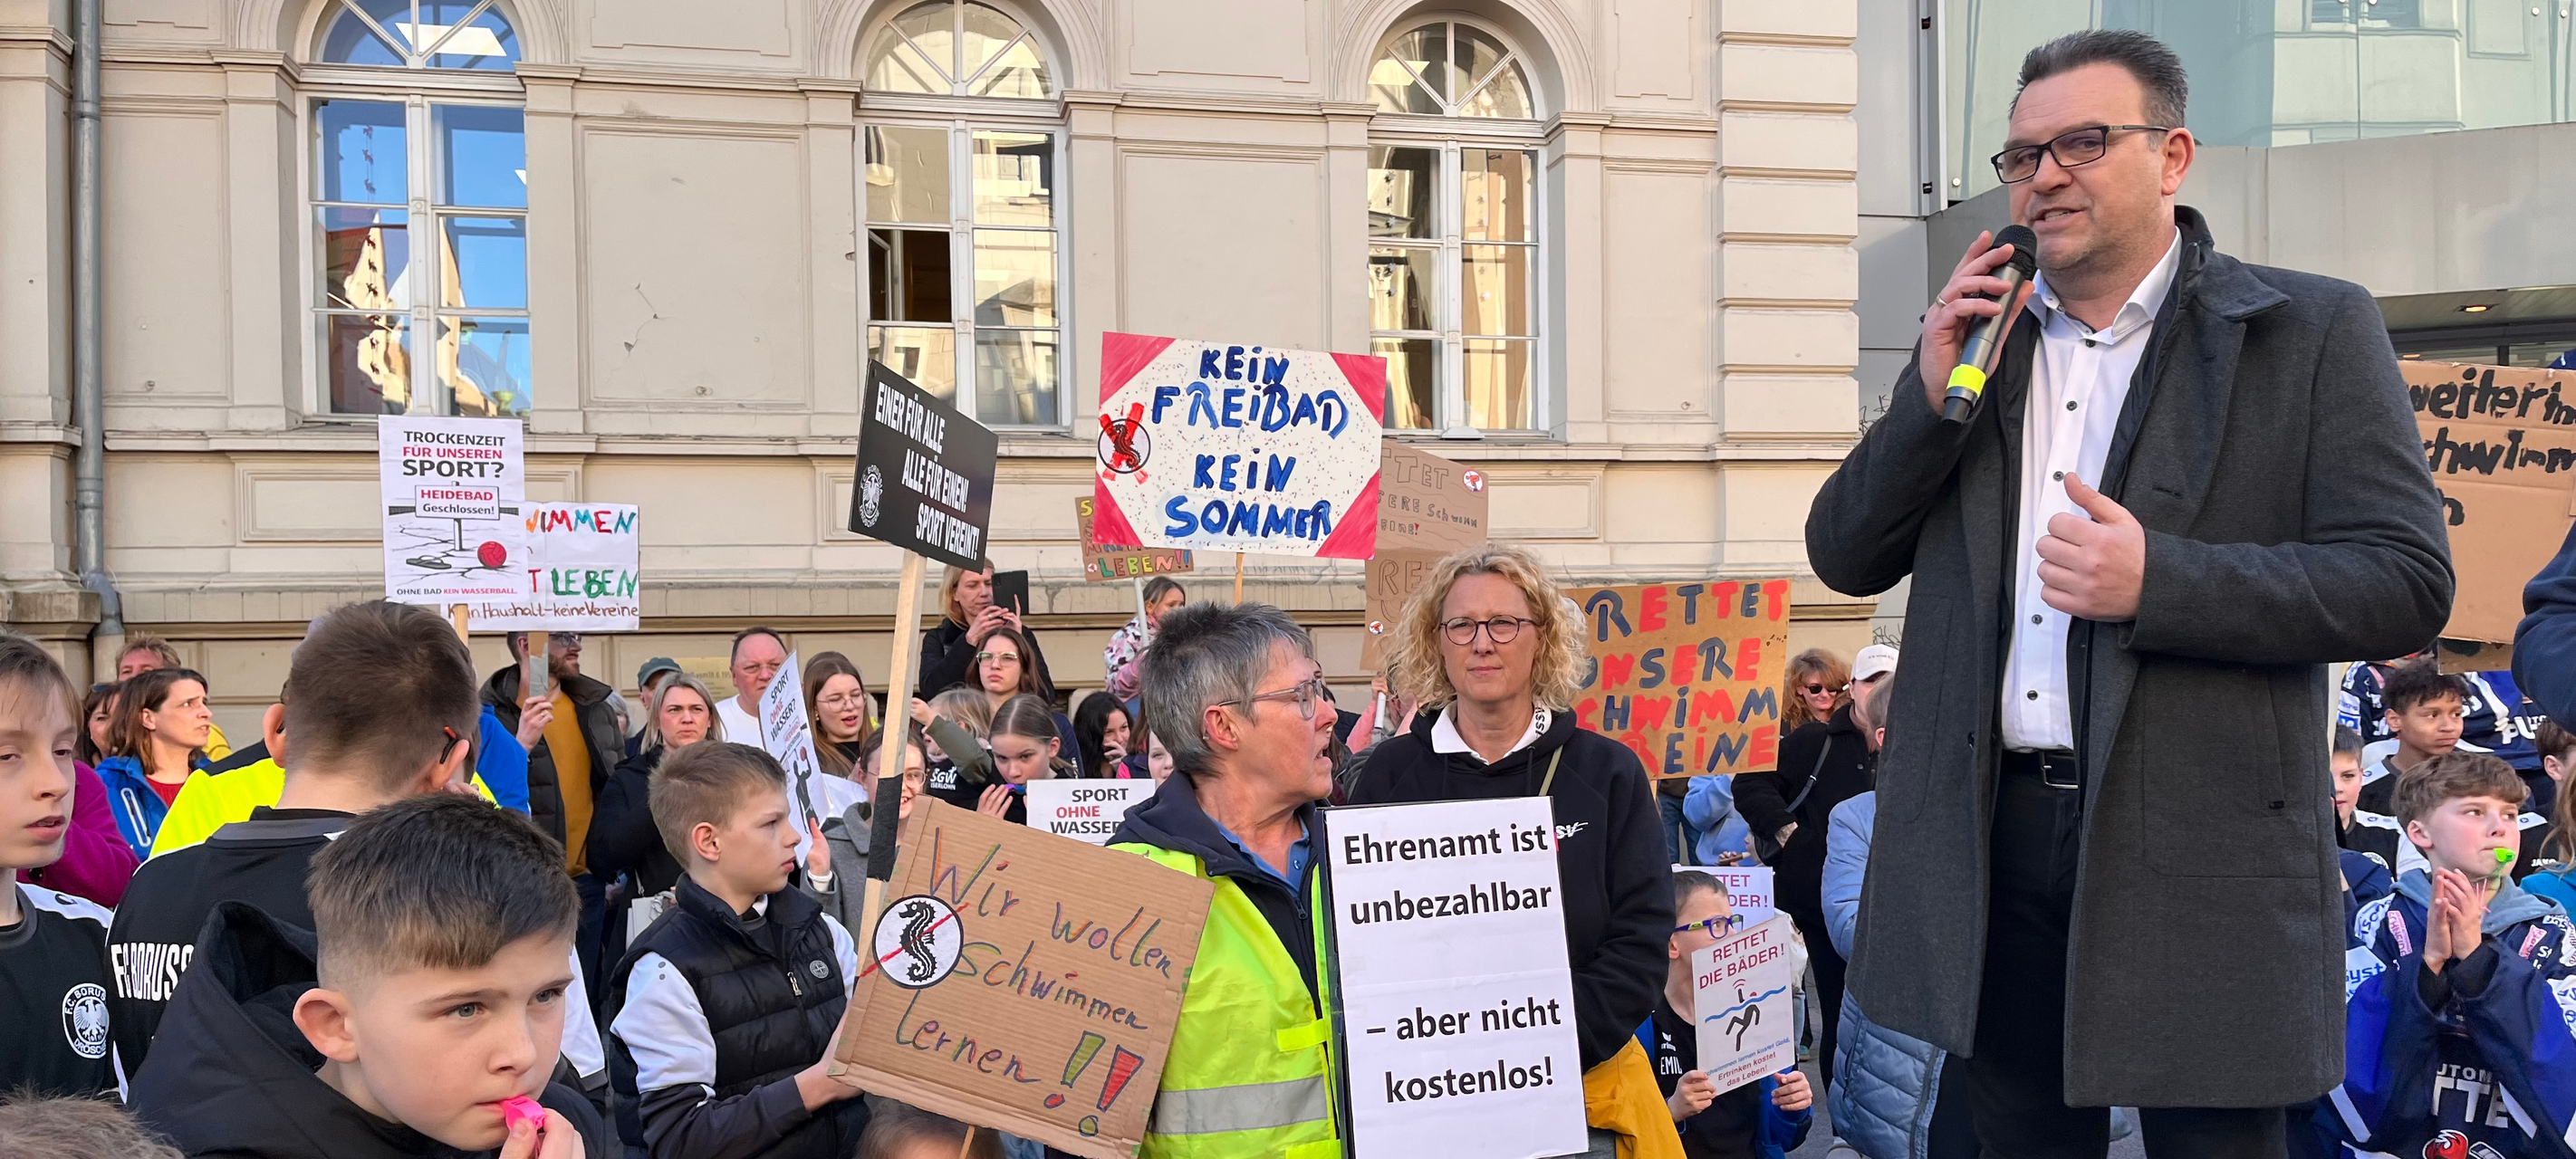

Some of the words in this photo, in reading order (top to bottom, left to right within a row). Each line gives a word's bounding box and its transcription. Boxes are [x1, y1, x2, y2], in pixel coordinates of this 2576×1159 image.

[875, 381, 906, 433] EINER
[904, 392, 924, 442] FÜR
[922, 408, 946, 455] ALLE
[402, 445, 433, 457] FÜR
[437, 447, 503, 459] UNSEREN
[403, 431, 505, 446] TROCKENZEIT
[402, 459, 505, 478] SPORT?
[901, 448, 926, 494] ALLE
[923, 455, 943, 503] FÜR
[940, 473, 969, 513] EINEN!
[420, 489, 494, 501] HEIDEBAD
[422, 503, 495, 514] Geschlossen!
[916, 502, 947, 549] SPORT
[944, 516, 980, 561] VEREINT!
[1165, 495, 1331, 541] SOMMER
[551, 568, 638, 599] LEBEN
[1585, 580, 1789, 642] RETTET
[771, 670, 789, 704] SPORT
[771, 698, 796, 741] WASSER?
[1072, 788, 1129, 802] SPORT
[1056, 805, 1101, 819] OHNE
[1344, 828, 1501, 865] Ehrenamt
[1510, 822, 1548, 852] ist
[1712, 875, 1750, 886] TET
[930, 827, 1020, 917] Wir
[1052, 902, 1171, 979] wollen
[1350, 881, 1552, 924] unbezahlbar
[1712, 929, 1769, 963] RETTET
[1698, 969, 1723, 990] DIE
[1397, 1007, 1470, 1040] aber
[1481, 997, 1562, 1031] nicht
[1385, 1056, 1553, 1103] kostenlos!
[1660, 1056, 1683, 1075] EMIL
[1717, 1062, 1752, 1081] Ertrinken
[1753, 1051, 1777, 1068] kostet
[1726, 1077, 1741, 1087] das
[1742, 1067, 1769, 1082] Leben!
